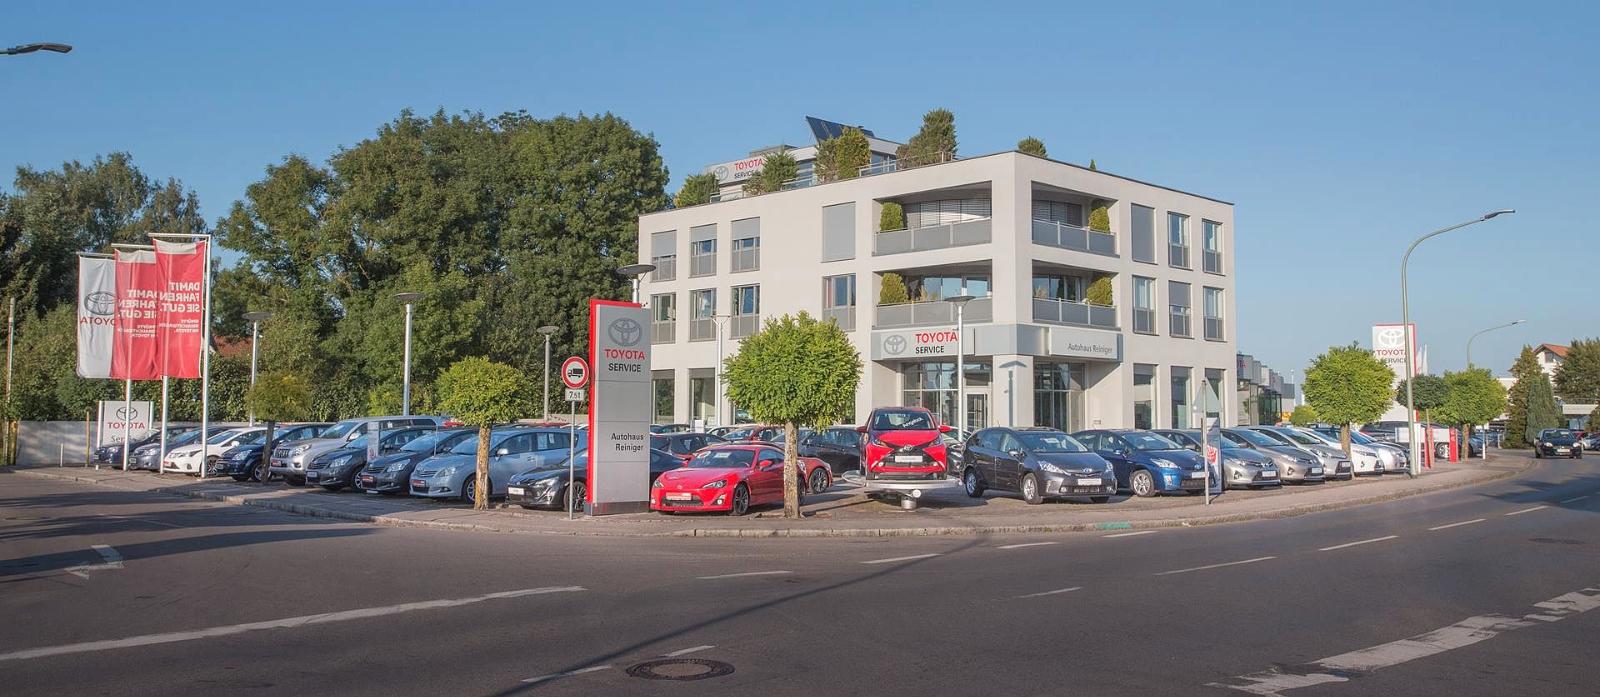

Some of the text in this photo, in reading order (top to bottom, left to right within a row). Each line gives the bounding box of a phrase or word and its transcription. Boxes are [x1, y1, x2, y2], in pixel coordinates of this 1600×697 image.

[734, 158, 763, 171] TOYOTA
[916, 331, 958, 343] TOYOTA
[915, 345, 945, 354] SERVICE
[1067, 343, 1092, 353] Autohaus
[604, 349, 645, 360] TOYOTA
[608, 362, 641, 373] SERVICE
[611, 433, 644, 441] Autohaus
[615, 443, 644, 453] Reiniger
